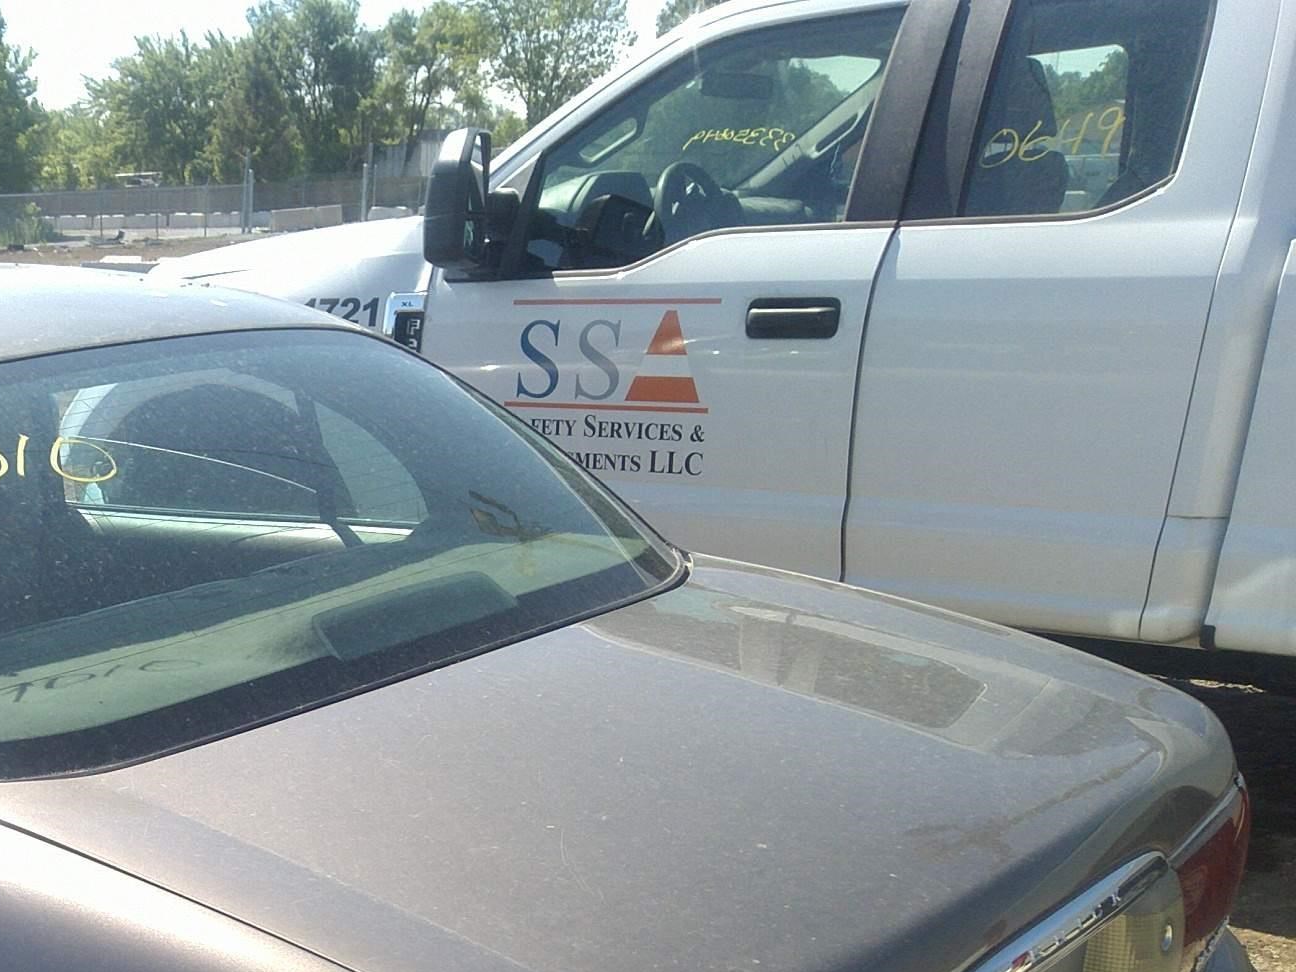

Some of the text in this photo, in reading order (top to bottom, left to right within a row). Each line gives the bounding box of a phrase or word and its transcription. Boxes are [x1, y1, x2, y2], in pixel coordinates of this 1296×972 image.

[979, 106, 1126, 168] 0649
[530, 418, 576, 436] FETY
[690, 424, 705, 442] &
[648, 450, 704, 476] LLC
